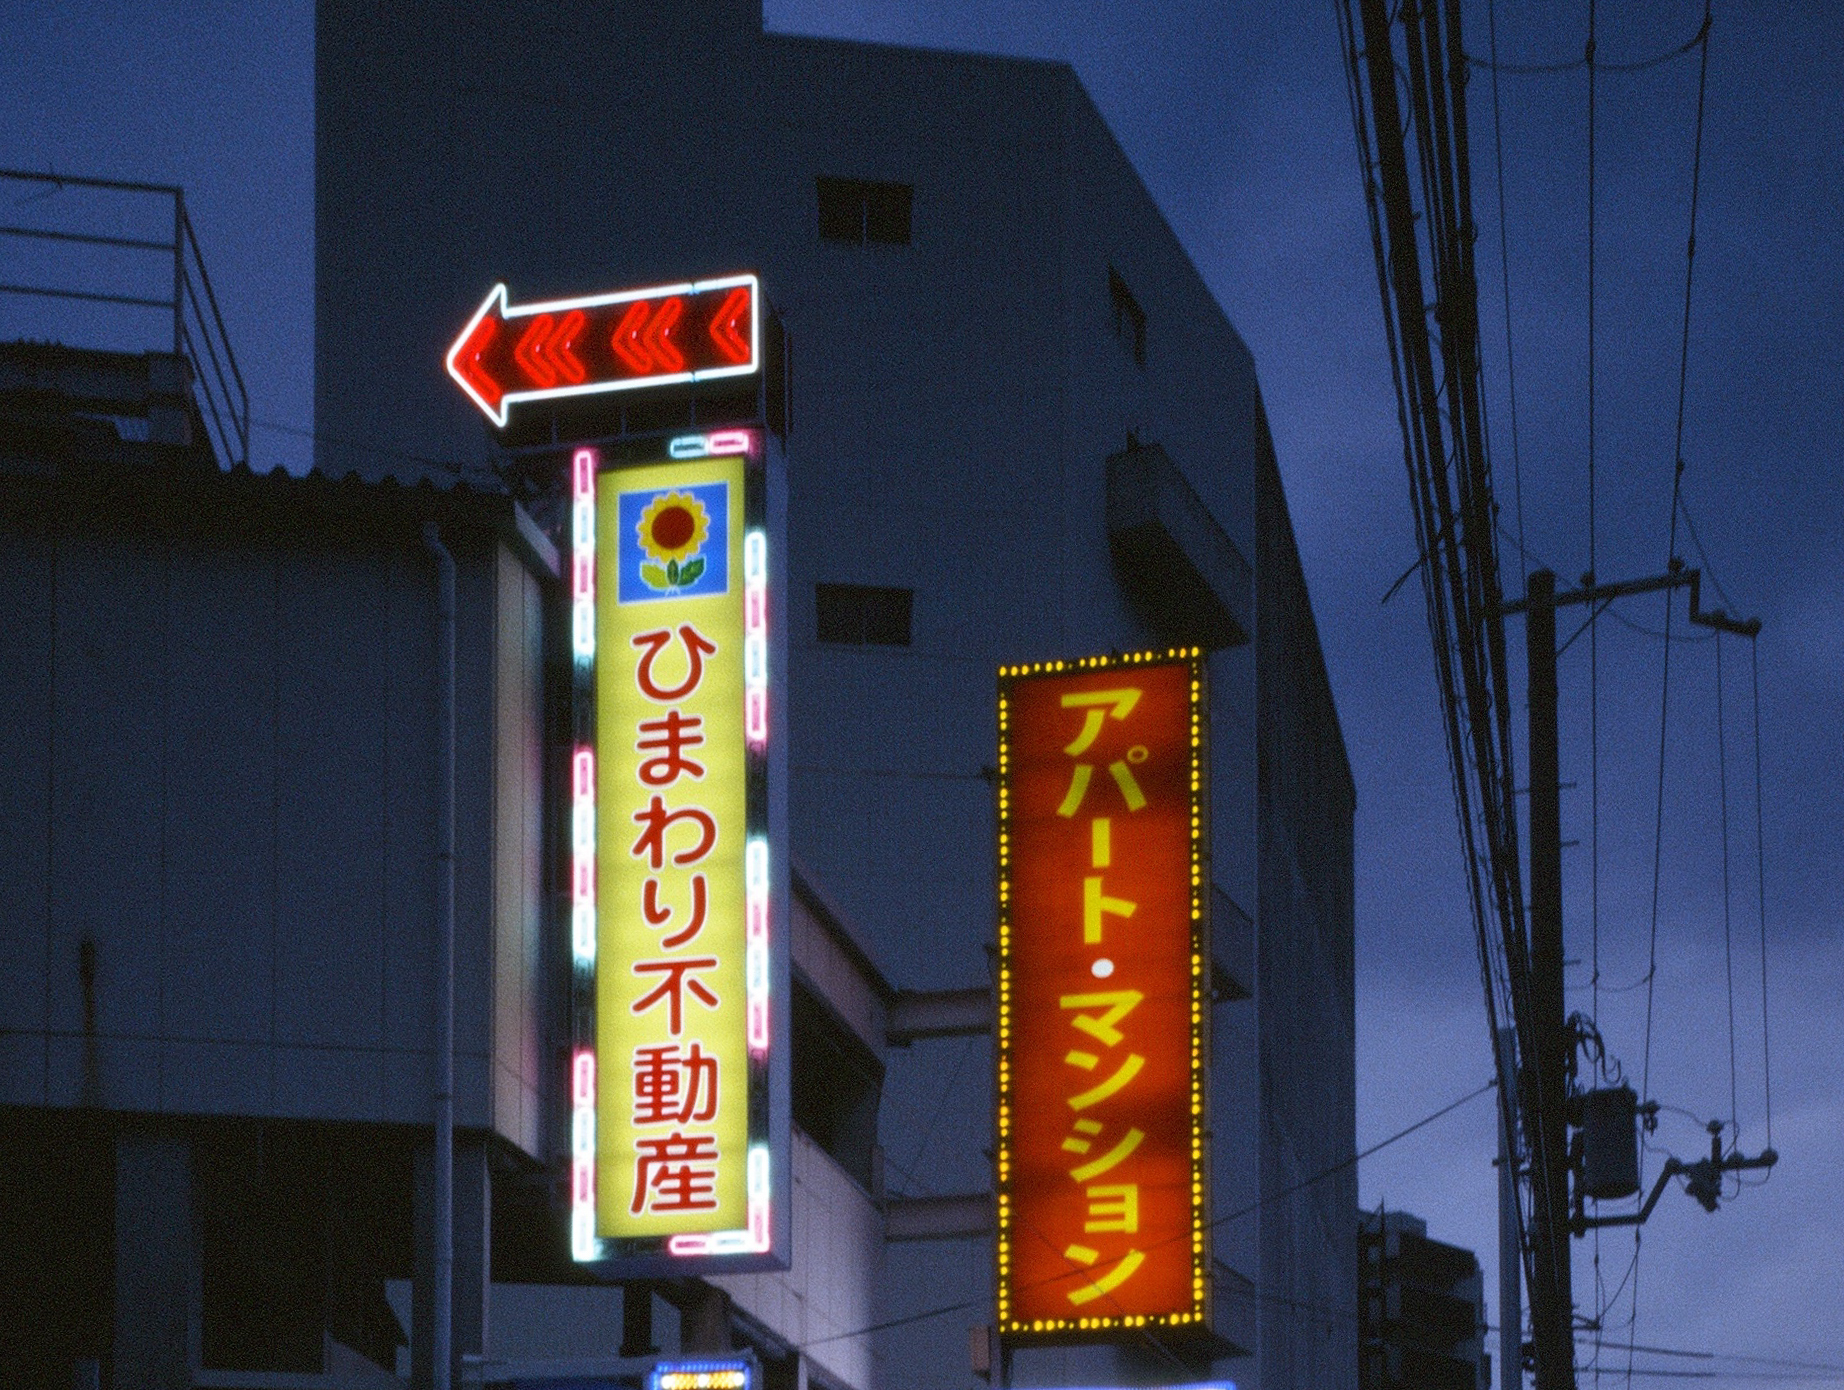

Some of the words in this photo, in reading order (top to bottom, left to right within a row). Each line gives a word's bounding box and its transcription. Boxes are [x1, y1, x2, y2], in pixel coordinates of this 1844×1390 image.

[631, 623, 720, 1213] ひまわり不動産
[1056, 687, 1149, 1306] アパート・マンション
